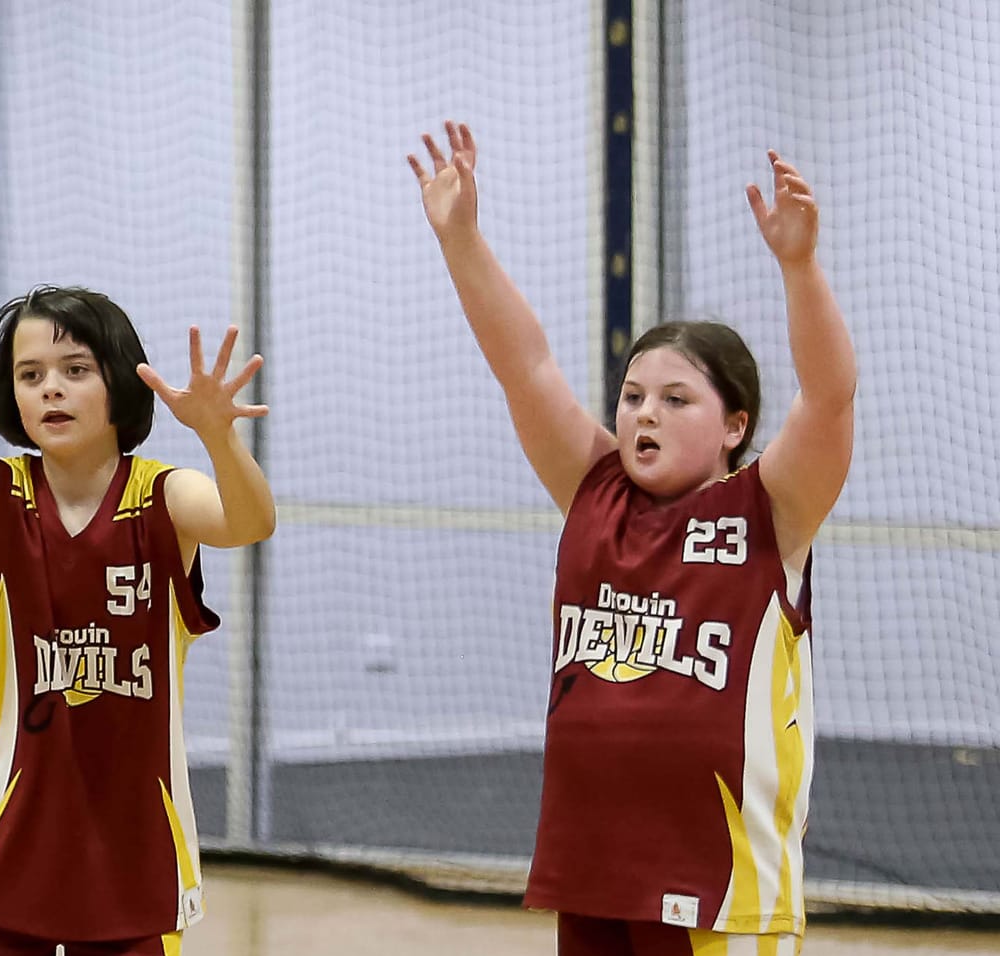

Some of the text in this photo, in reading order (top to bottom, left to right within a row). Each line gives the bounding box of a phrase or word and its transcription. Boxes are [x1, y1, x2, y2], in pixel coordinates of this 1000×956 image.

[683, 516, 748, 565] 23
[106, 562, 152, 616] 54
[597, 582, 677, 617] Drouin
[554, 604, 732, 691] DEVILS
